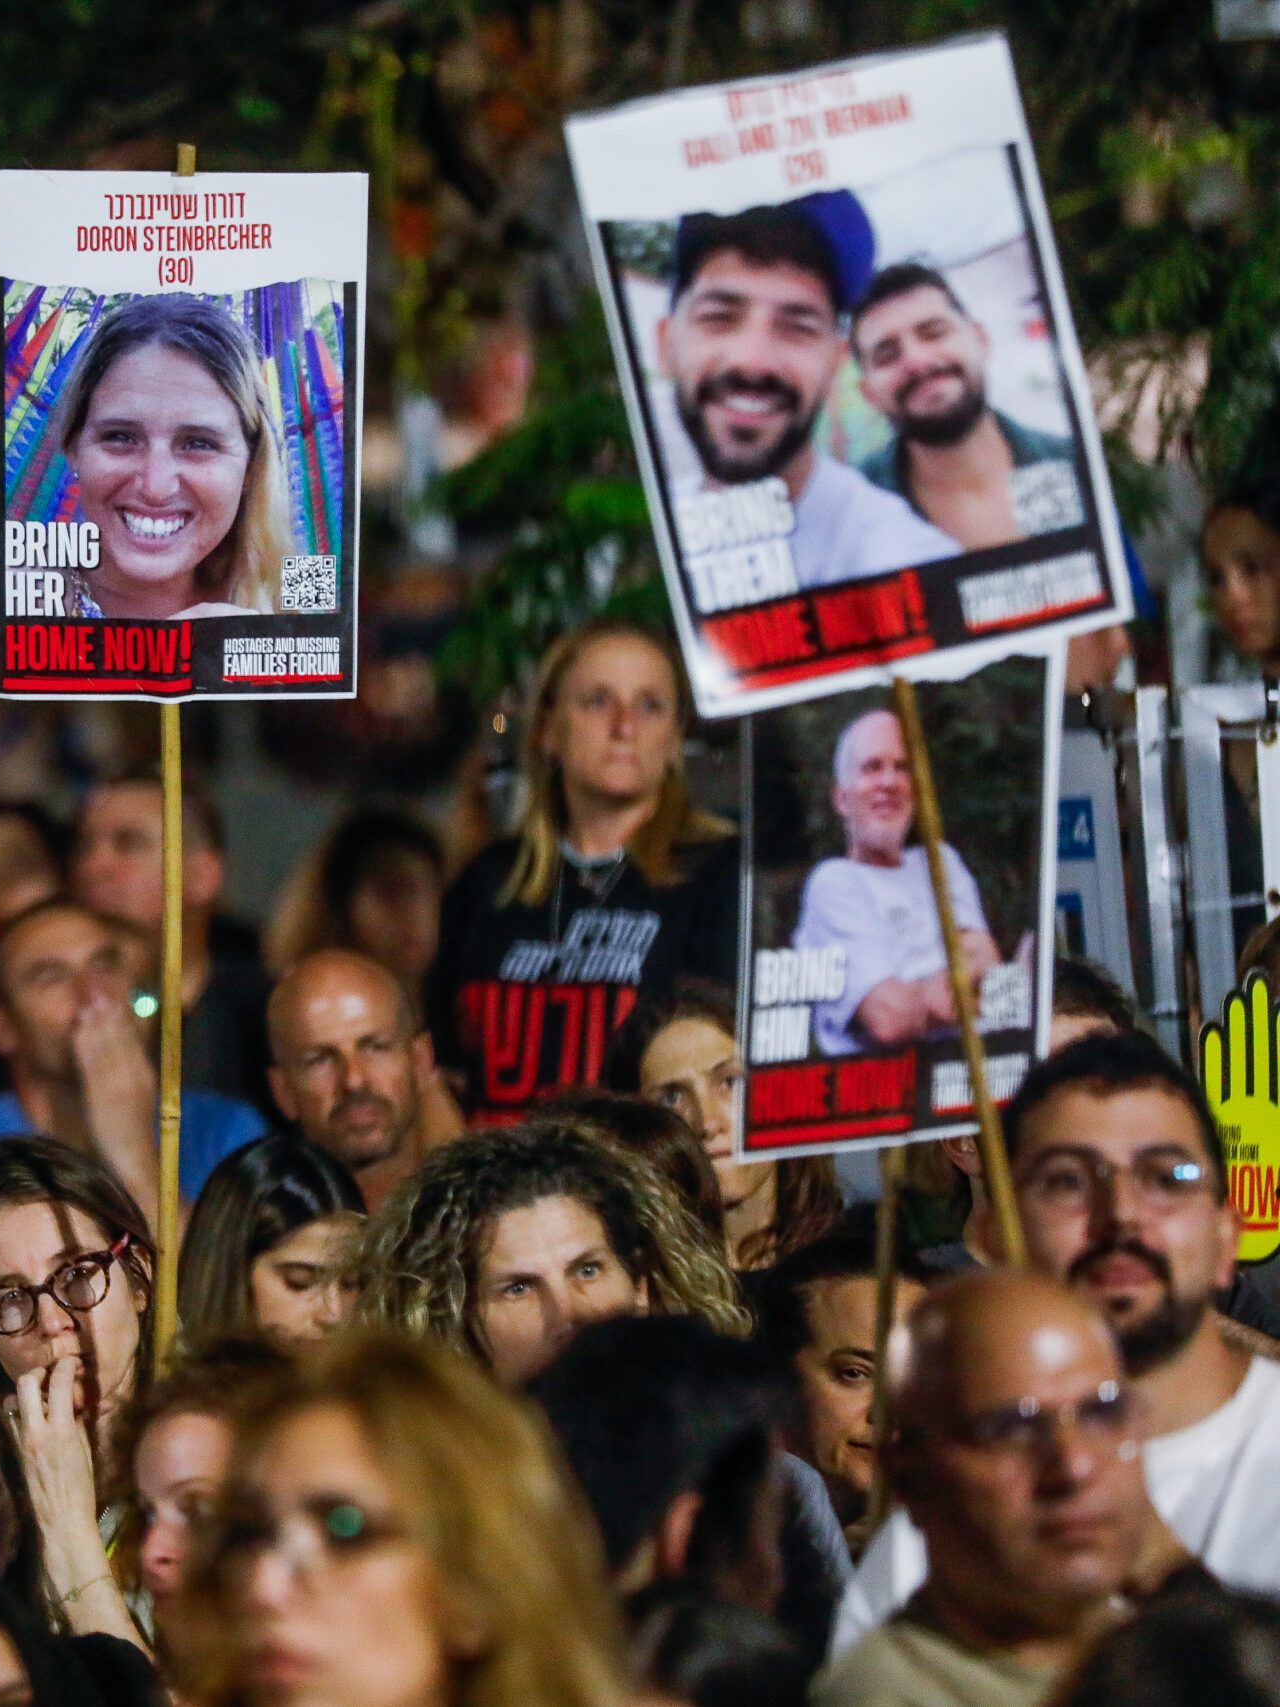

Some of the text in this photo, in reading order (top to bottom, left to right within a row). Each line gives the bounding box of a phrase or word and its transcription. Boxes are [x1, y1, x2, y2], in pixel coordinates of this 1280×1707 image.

[104, 192, 246, 222] דורון שטיינברכר
[77, 223, 272, 252] DORON STEINBRECHER
[158, 255, 194, 286] (30)
[5, 520, 100, 569] BRING
[5, 571, 66, 617] HER
[5, 621, 192, 674] HOME NOW!
[223, 637, 340, 653] HOSTAGES AND MISSING
[223, 653, 340, 676] FAMILIES FORUM
